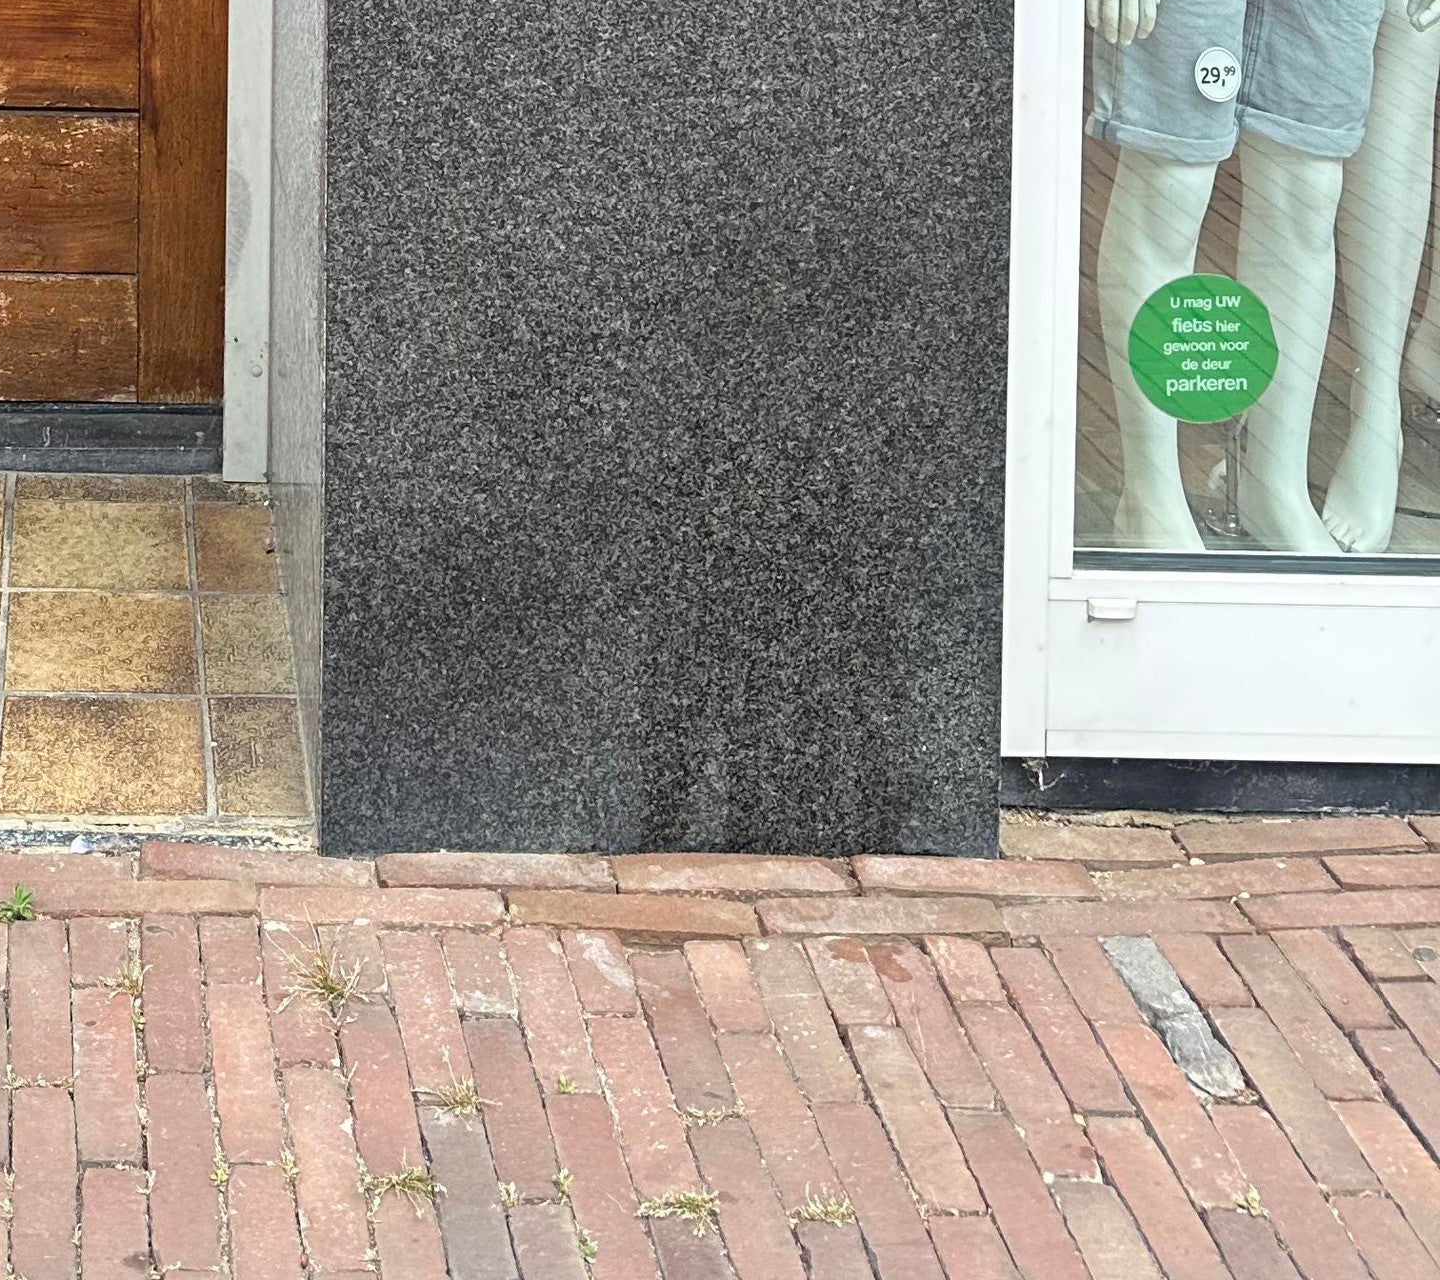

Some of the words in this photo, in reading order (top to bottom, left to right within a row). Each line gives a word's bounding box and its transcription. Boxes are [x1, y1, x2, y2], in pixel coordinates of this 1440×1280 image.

[1200, 65, 1236, 87] 29,99
[1170, 297, 1180, 308] U
[1183, 299, 1212, 311] mag
[1172, 317, 1212, 333] fiets
[1215, 320, 1241, 332] hier
[1163, 341, 1216, 355] gewoon
[1219, 341, 1250, 351] voor
[1181, 358, 1198, 370] de
[1201, 358, 1232, 370] deur
[1166, 375, 1248, 397] parkeren
